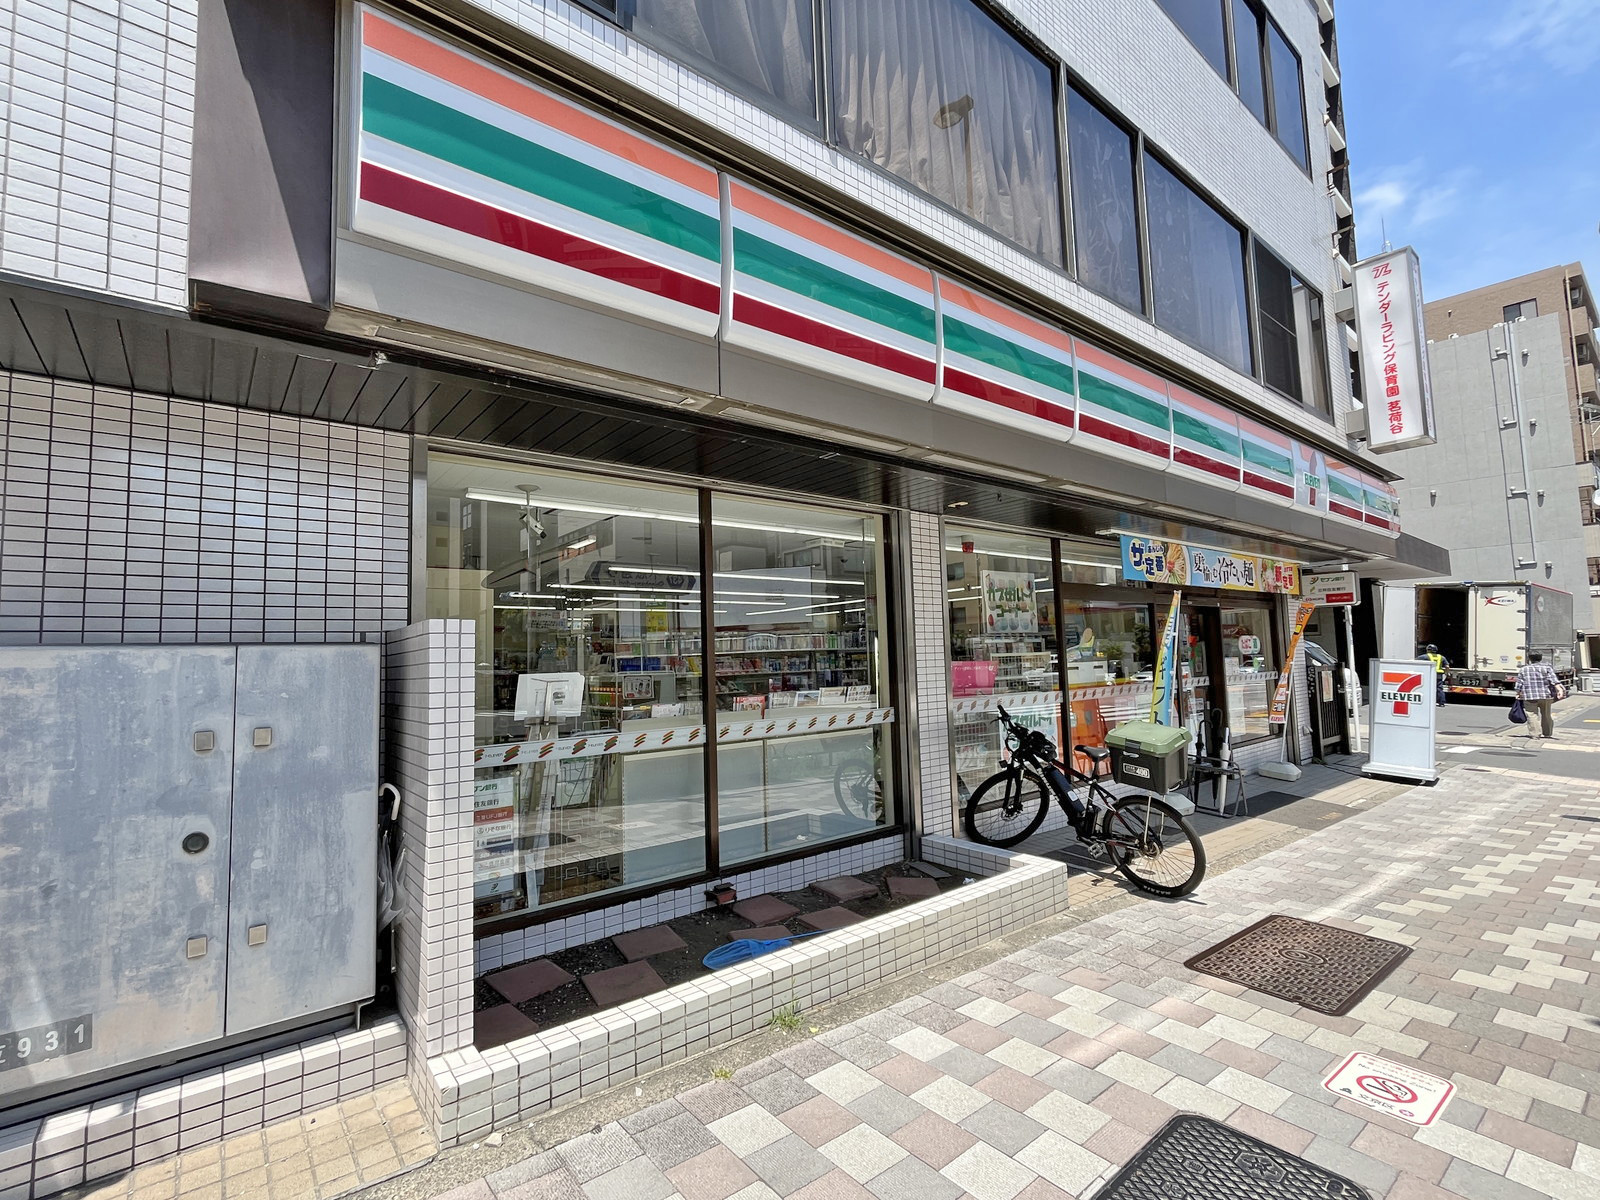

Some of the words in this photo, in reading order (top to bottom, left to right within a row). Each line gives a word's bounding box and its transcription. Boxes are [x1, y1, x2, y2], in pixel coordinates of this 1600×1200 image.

[1377, 281, 1400, 398] テンダーラビング保育園
[1387, 401, 1404, 435] 茗荷谷
